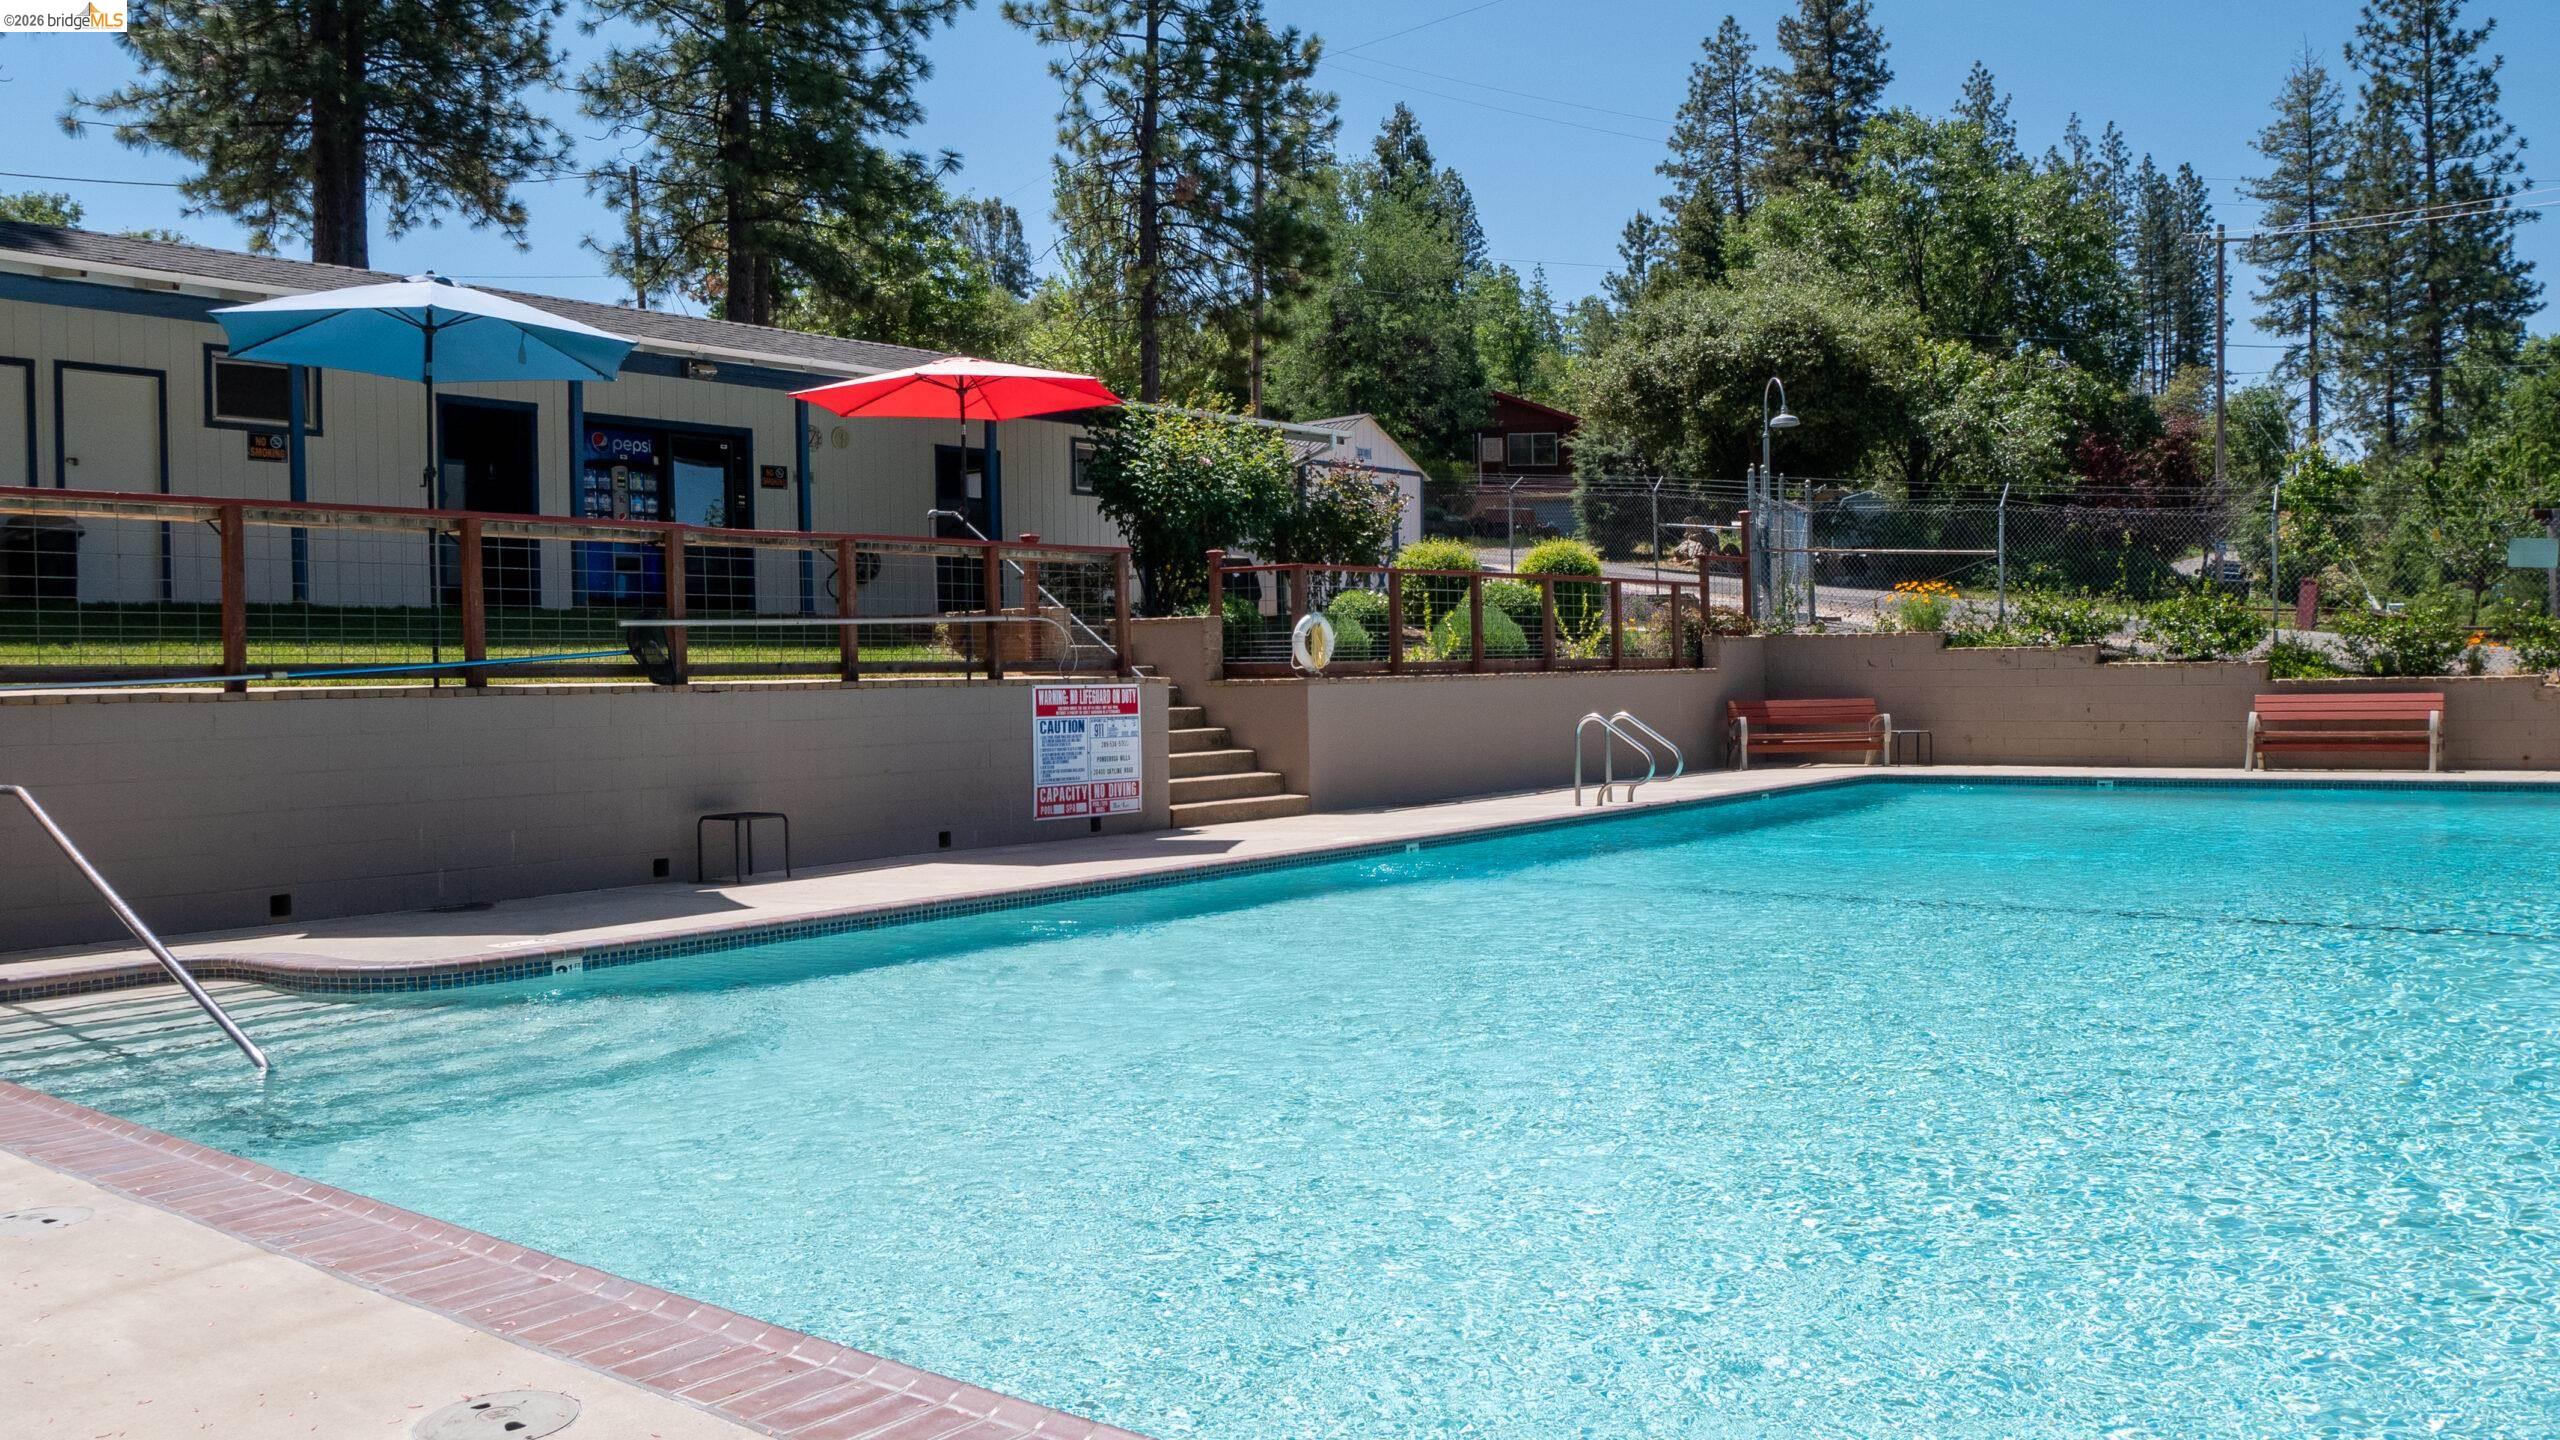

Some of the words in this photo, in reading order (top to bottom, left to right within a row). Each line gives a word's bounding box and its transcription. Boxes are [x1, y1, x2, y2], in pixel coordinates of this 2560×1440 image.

[255, 436, 267, 447] NO
[612, 438, 652, 454] pepsi
[250, 447, 286, 459] SMOKING
[1038, 689, 1069, 705] WARNING:
[1070, 689, 1078, 705] NO
[1079, 689, 1111, 704] LIFEGUARD
[1112, 689, 1121, 704] ON
[1121, 688, 1137, 703] DUTY
[1040, 719, 1085, 734] CAUTION
[1094, 723, 1104, 737] 911
[1040, 785, 1087, 803] CAPACITY
[1094, 784, 1105, 798] NO
[1108, 782, 1137, 798] DIVING
[1040, 805, 1053, 815] POOL
[1066, 804, 1076, 813] SPA
